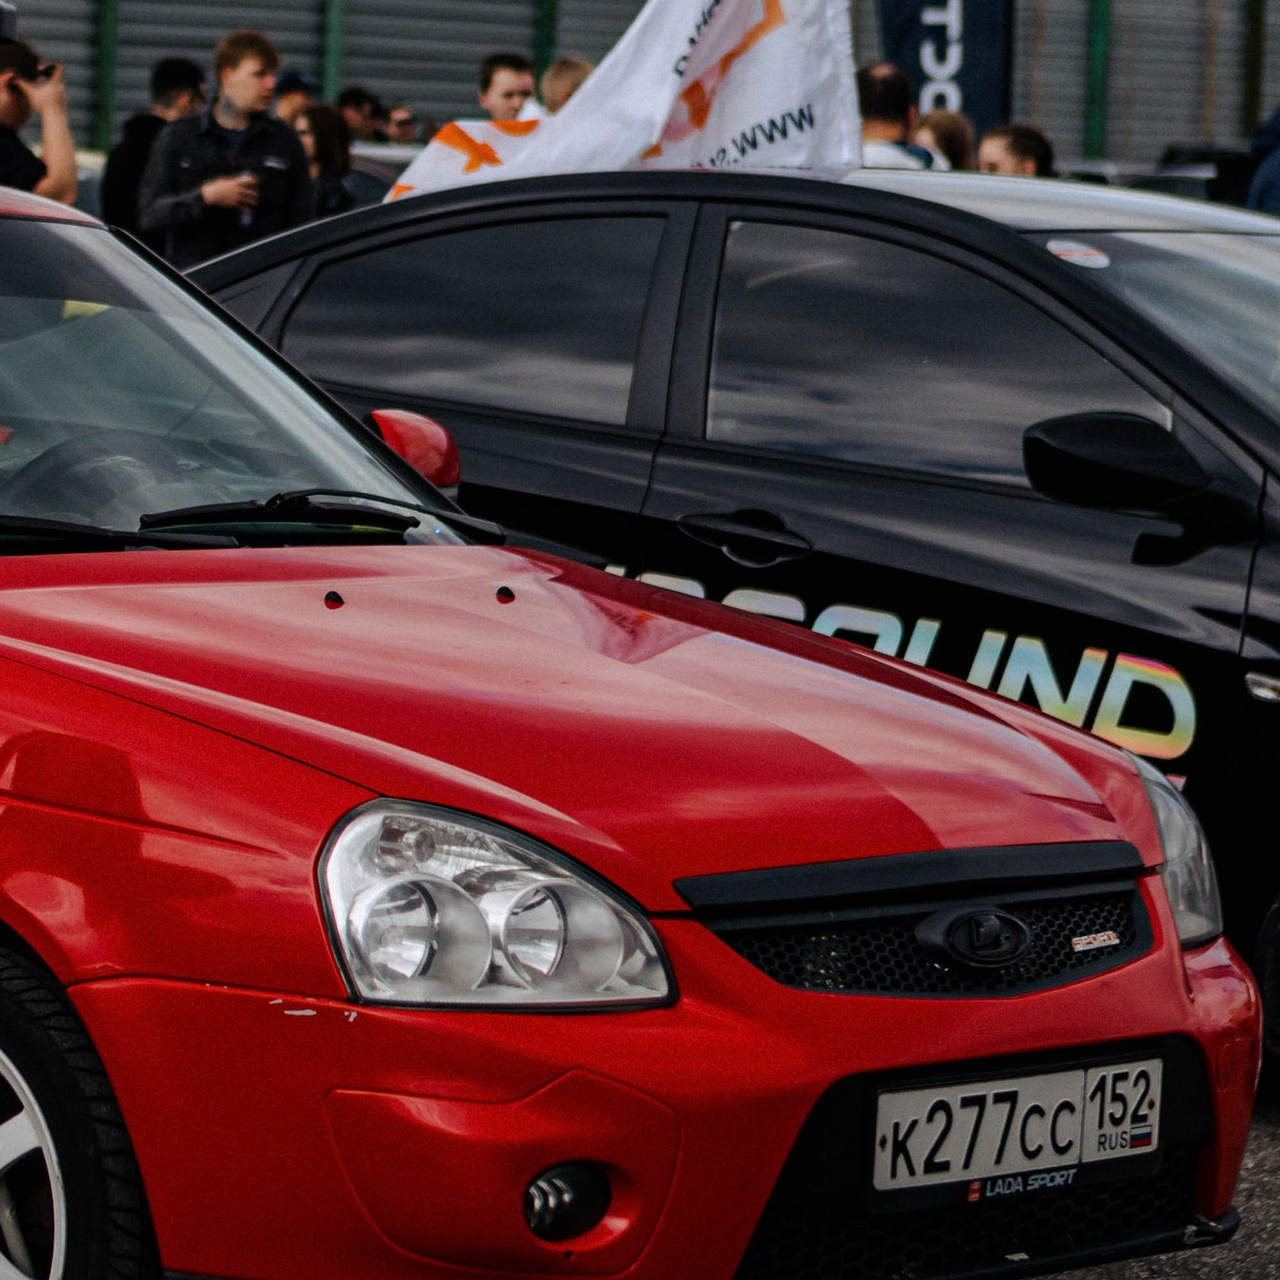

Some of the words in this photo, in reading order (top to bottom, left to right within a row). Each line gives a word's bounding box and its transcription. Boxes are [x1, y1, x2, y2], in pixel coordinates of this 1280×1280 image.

[1088, 1069, 1152, 1131] 152
[1096, 1130, 1129, 1153] RUS
[985, 1176, 1023, 1197] LADA
[1026, 1168, 1078, 1190] SPORT
